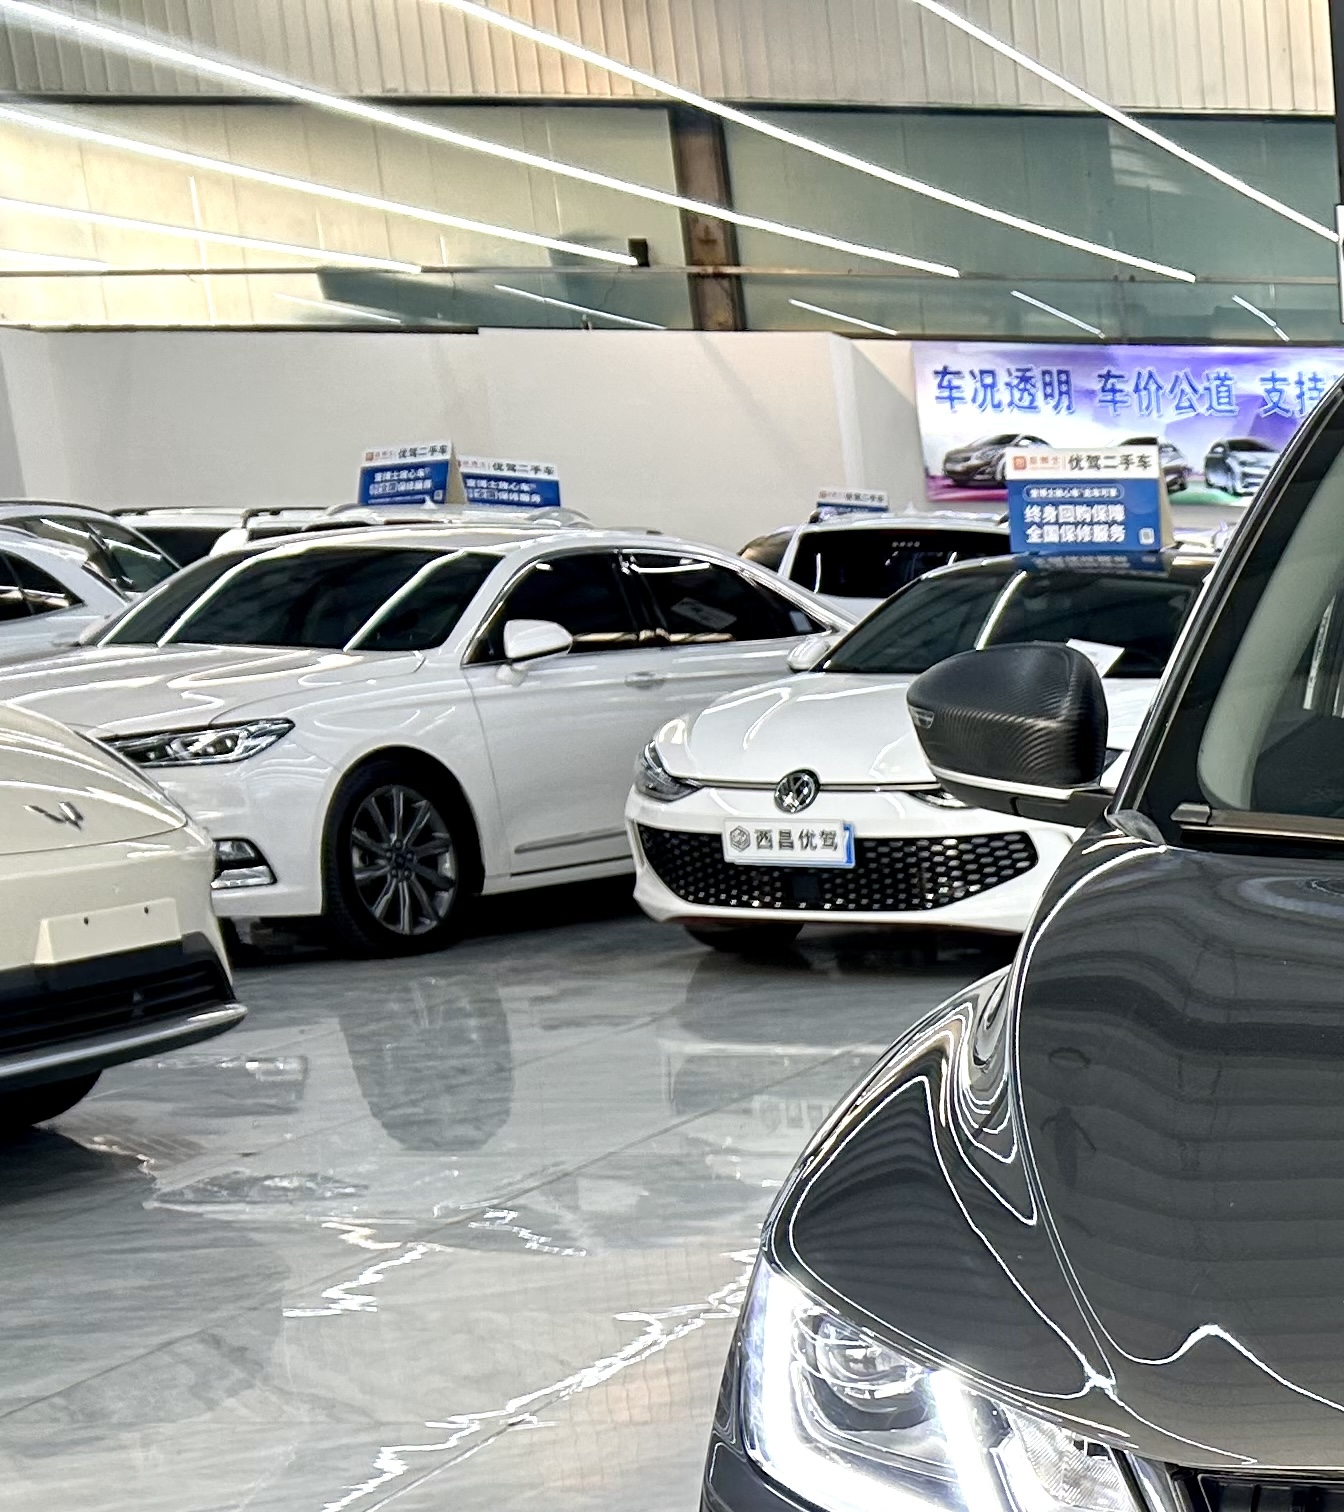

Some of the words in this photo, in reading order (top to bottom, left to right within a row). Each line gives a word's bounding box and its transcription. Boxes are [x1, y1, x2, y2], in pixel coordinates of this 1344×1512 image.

[933, 365, 1076, 414] 车况透明
[1097, 368, 1240, 417] 车价公道
[1259, 370, 1341, 417] 支持
[1068, 453, 1153, 471] 优驾二手车
[1025, 524, 1126, 543] 全国保修服务
[754, 828, 838, 851] 西昌优驾
